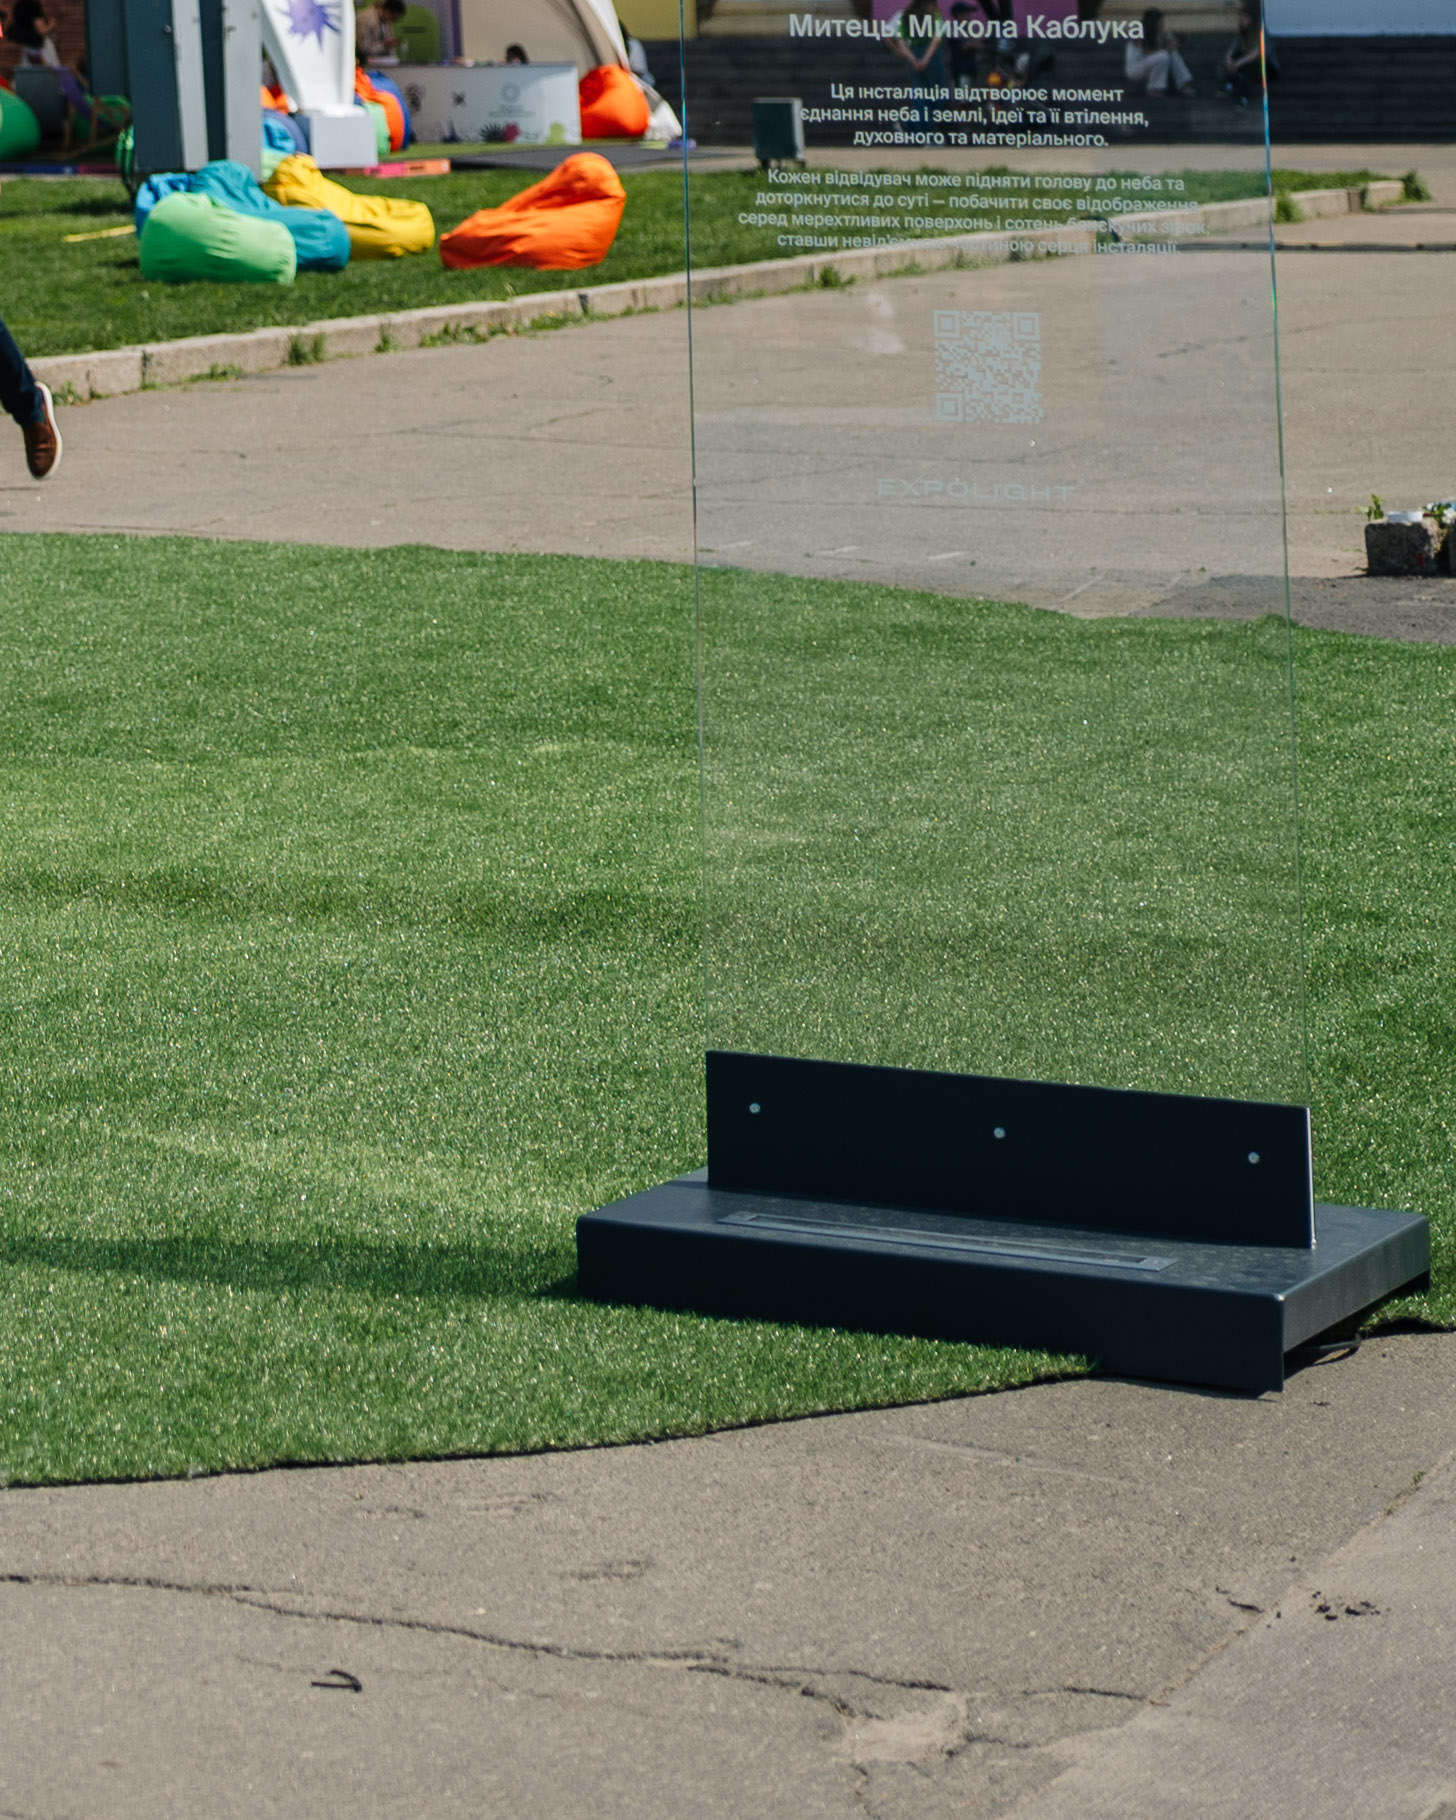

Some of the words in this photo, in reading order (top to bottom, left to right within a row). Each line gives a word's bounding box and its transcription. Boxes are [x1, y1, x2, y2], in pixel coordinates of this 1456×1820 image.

[789, 13, 900, 42] Митець:
[908, 13, 1019, 42] Микола
[1026, 13, 1144, 43] Каблука
[830, 82, 856, 102] Ця
[858, 83, 950, 102] інсталяція
[954, 84, 1048, 104] відтворює
[1052, 88, 1124, 102] момент
[800, 109, 874, 125] єднання
[878, 107, 920, 124] неба
[932, 108, 987, 126] землі,
[991, 108, 1023, 126] ідеї
[1027, 111, 1047, 125] та
[1050, 108, 1061, 125] її
[1064, 108, 1150, 128] втілення,
[853, 131, 944, 147] духовного
[948, 132, 968, 146] та
[972, 130, 1109, 149] матеріального.
[767, 168, 822, 186] Кожен
[825, 169, 913, 189] відвідувач
[916, 173, 961, 188] може
[966, 171, 1031, 190] підняти
[1035, 175, 1092, 193] голову
[1095, 177, 1118, 192] до
[1121, 175, 1162, 192] неба
[1165, 178, 1185, 192] та
[755, 191, 870, 210] доторкнутися
[873, 193, 894, 210] до
[897, 192, 929, 211] суті
[948, 194, 1029, 211] побачити
[1032, 197, 1073, 211] своє
[1076, 196, 1198, 215] відображення
[738, 213, 788, 228] серед
[791, 214, 900, 230] мерехтливих
[904, 215, 992, 232] поверхонь
[1005, 218, 1063, 232] сотень
[777, 233, 839, 248] ставши
[1037, 241, 1088, 257] серця
[1092, 240, 1179, 257] інсталяції.
[876, 476, 1078, 503] EXPOLIGHT
